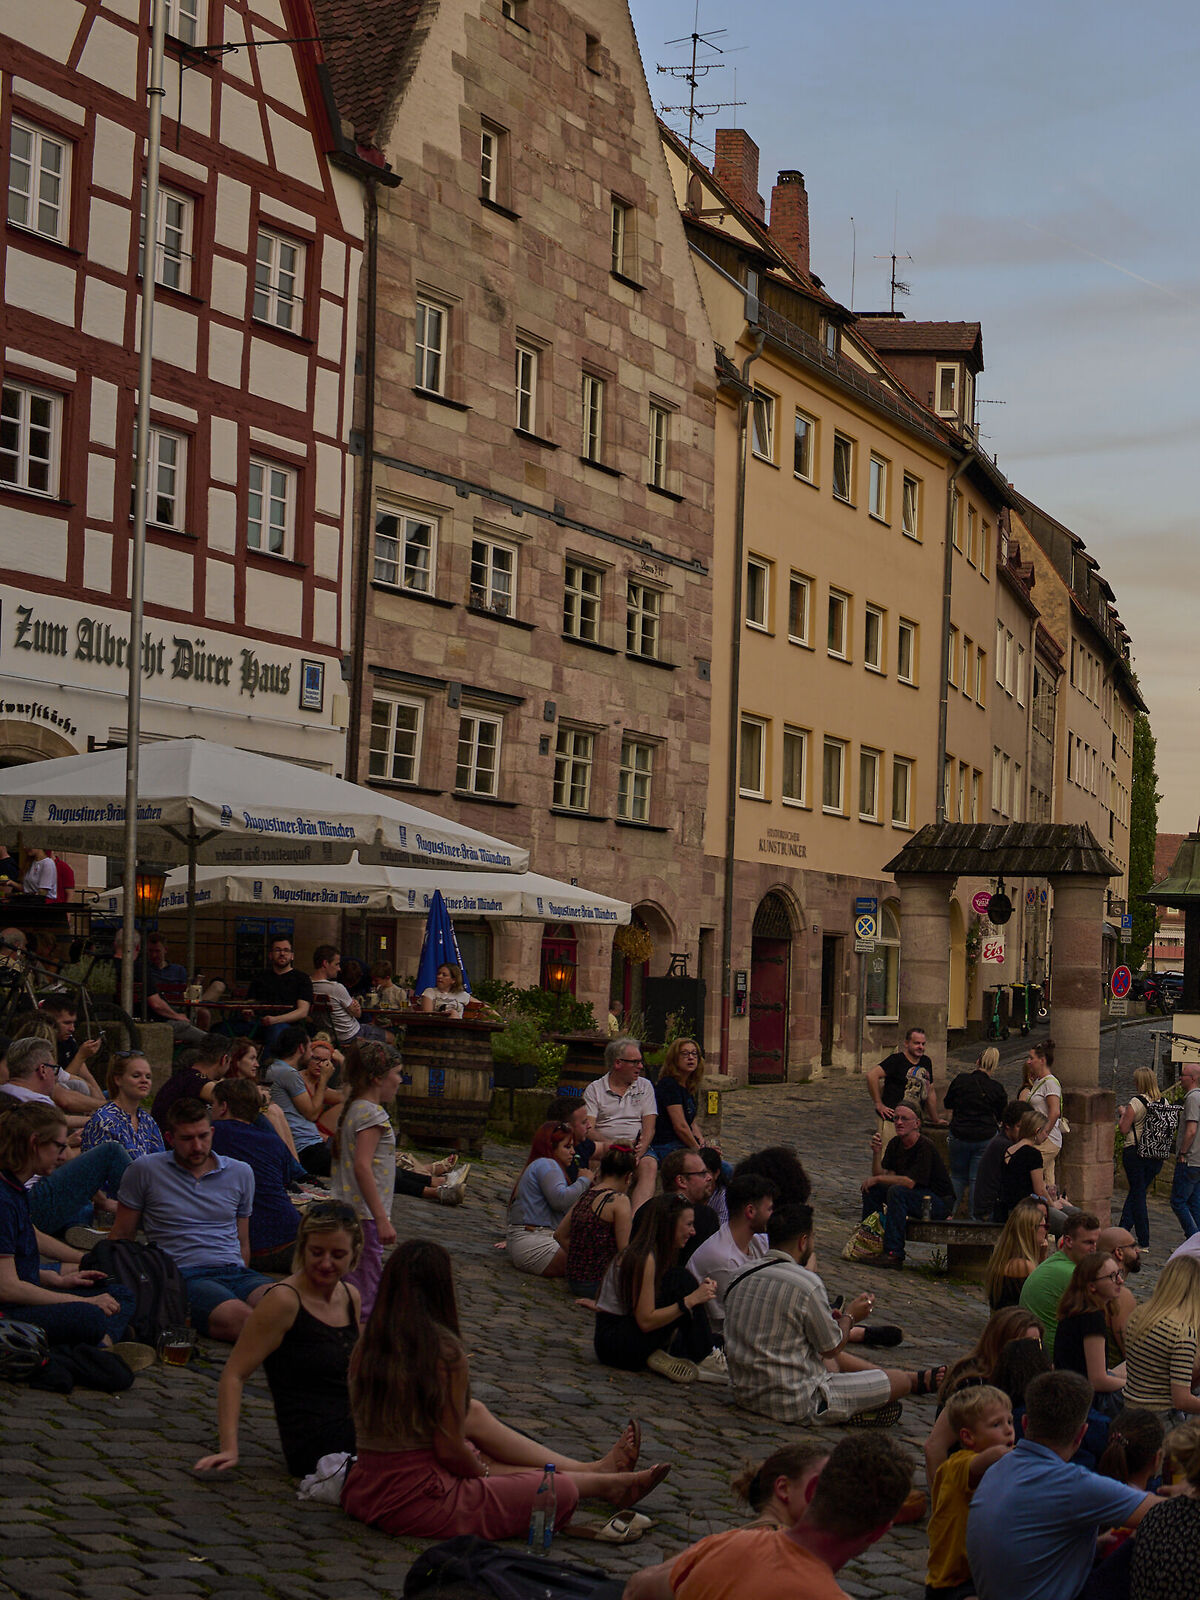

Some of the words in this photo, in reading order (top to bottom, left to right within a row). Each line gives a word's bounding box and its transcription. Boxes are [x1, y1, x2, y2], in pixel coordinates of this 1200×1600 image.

[15, 605, 68, 656] Zum
[171, 635, 233, 686] Dürer
[240, 648, 292, 698] Haus
[136, 804, 162, 821] ünchen
[317, 820, 356, 838] München
[478, 848, 511, 866] München
[759, 838, 807, 858] KUNSTBUNKER
[340, 890, 369, 904] München
[1122, 916, 1129, 927] P
[983, 941, 1003, 960] Eis
